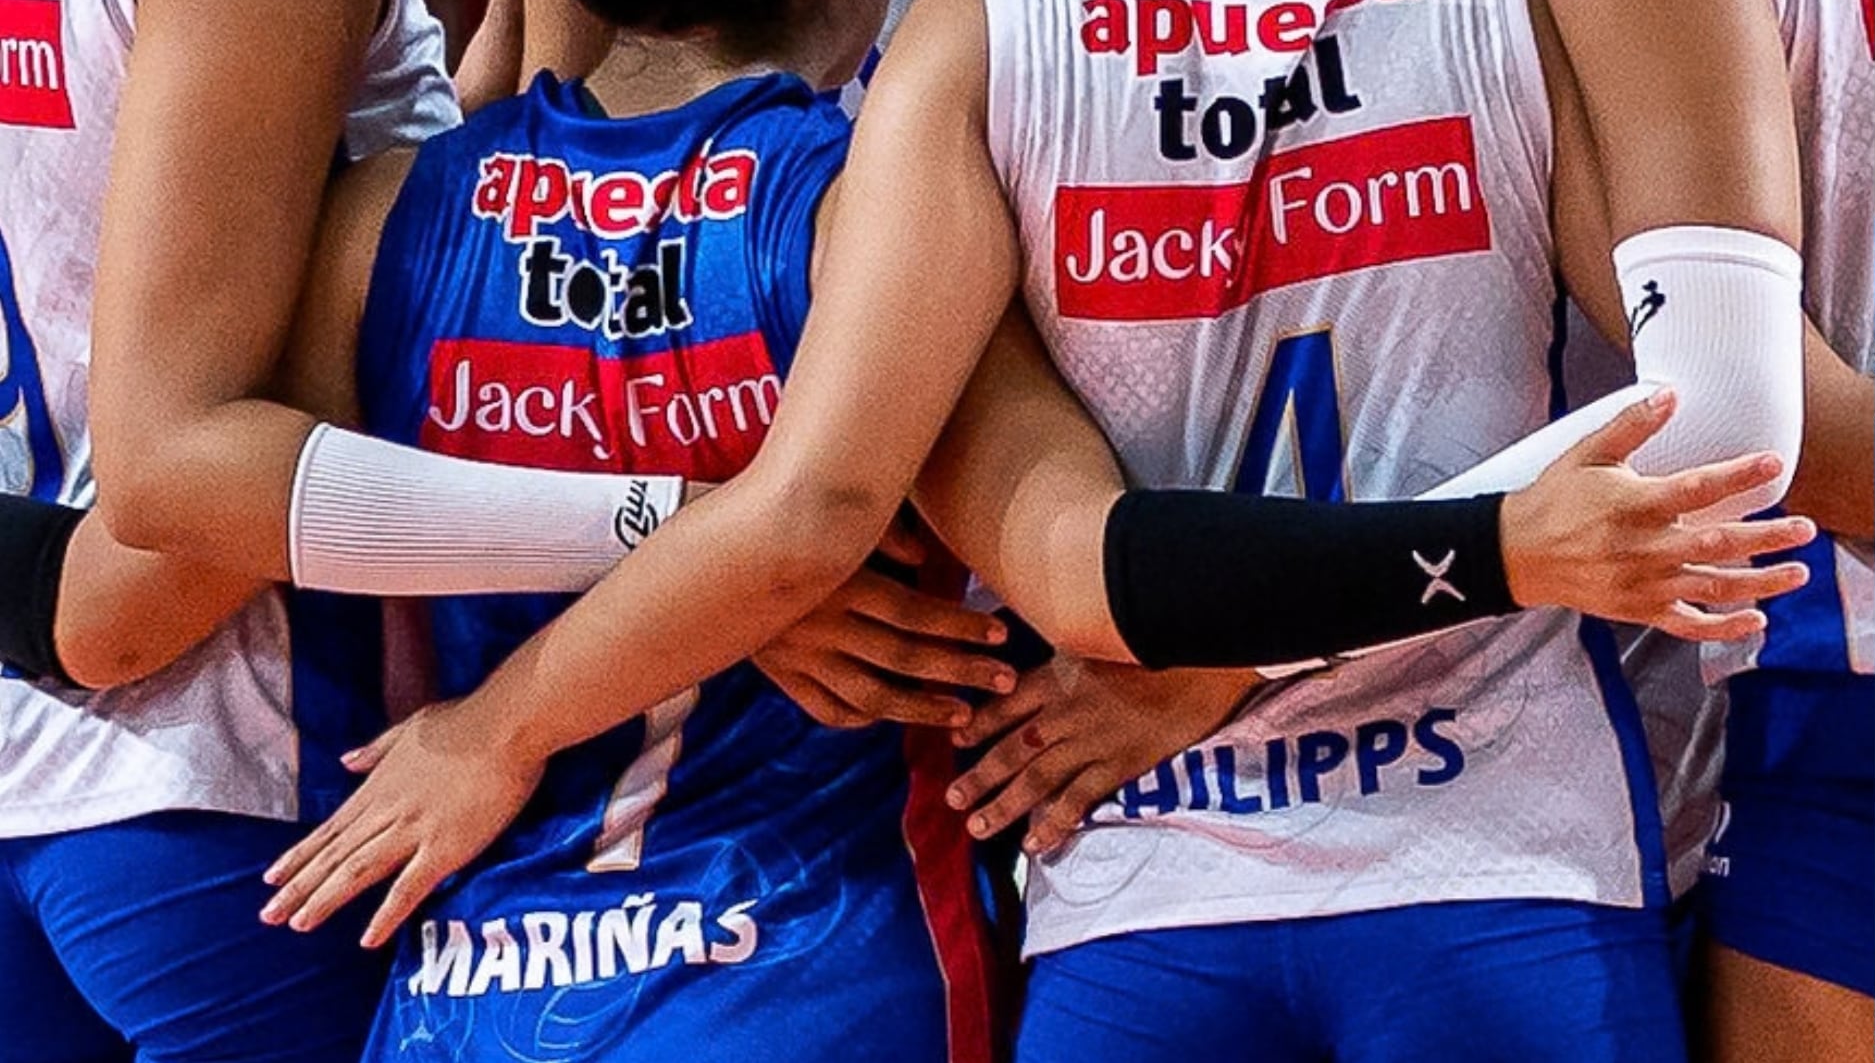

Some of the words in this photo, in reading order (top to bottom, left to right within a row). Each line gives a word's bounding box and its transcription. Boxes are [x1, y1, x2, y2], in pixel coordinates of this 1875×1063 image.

[1065, 208, 1243, 289] Jack
[1268, 160, 1472, 245] Form
[428, 358, 611, 461] Jack
[627, 373, 783, 446] Form
[1086, 707, 1466, 824] HILIPPS
[407, 892, 760, 998] MARIÑAS
